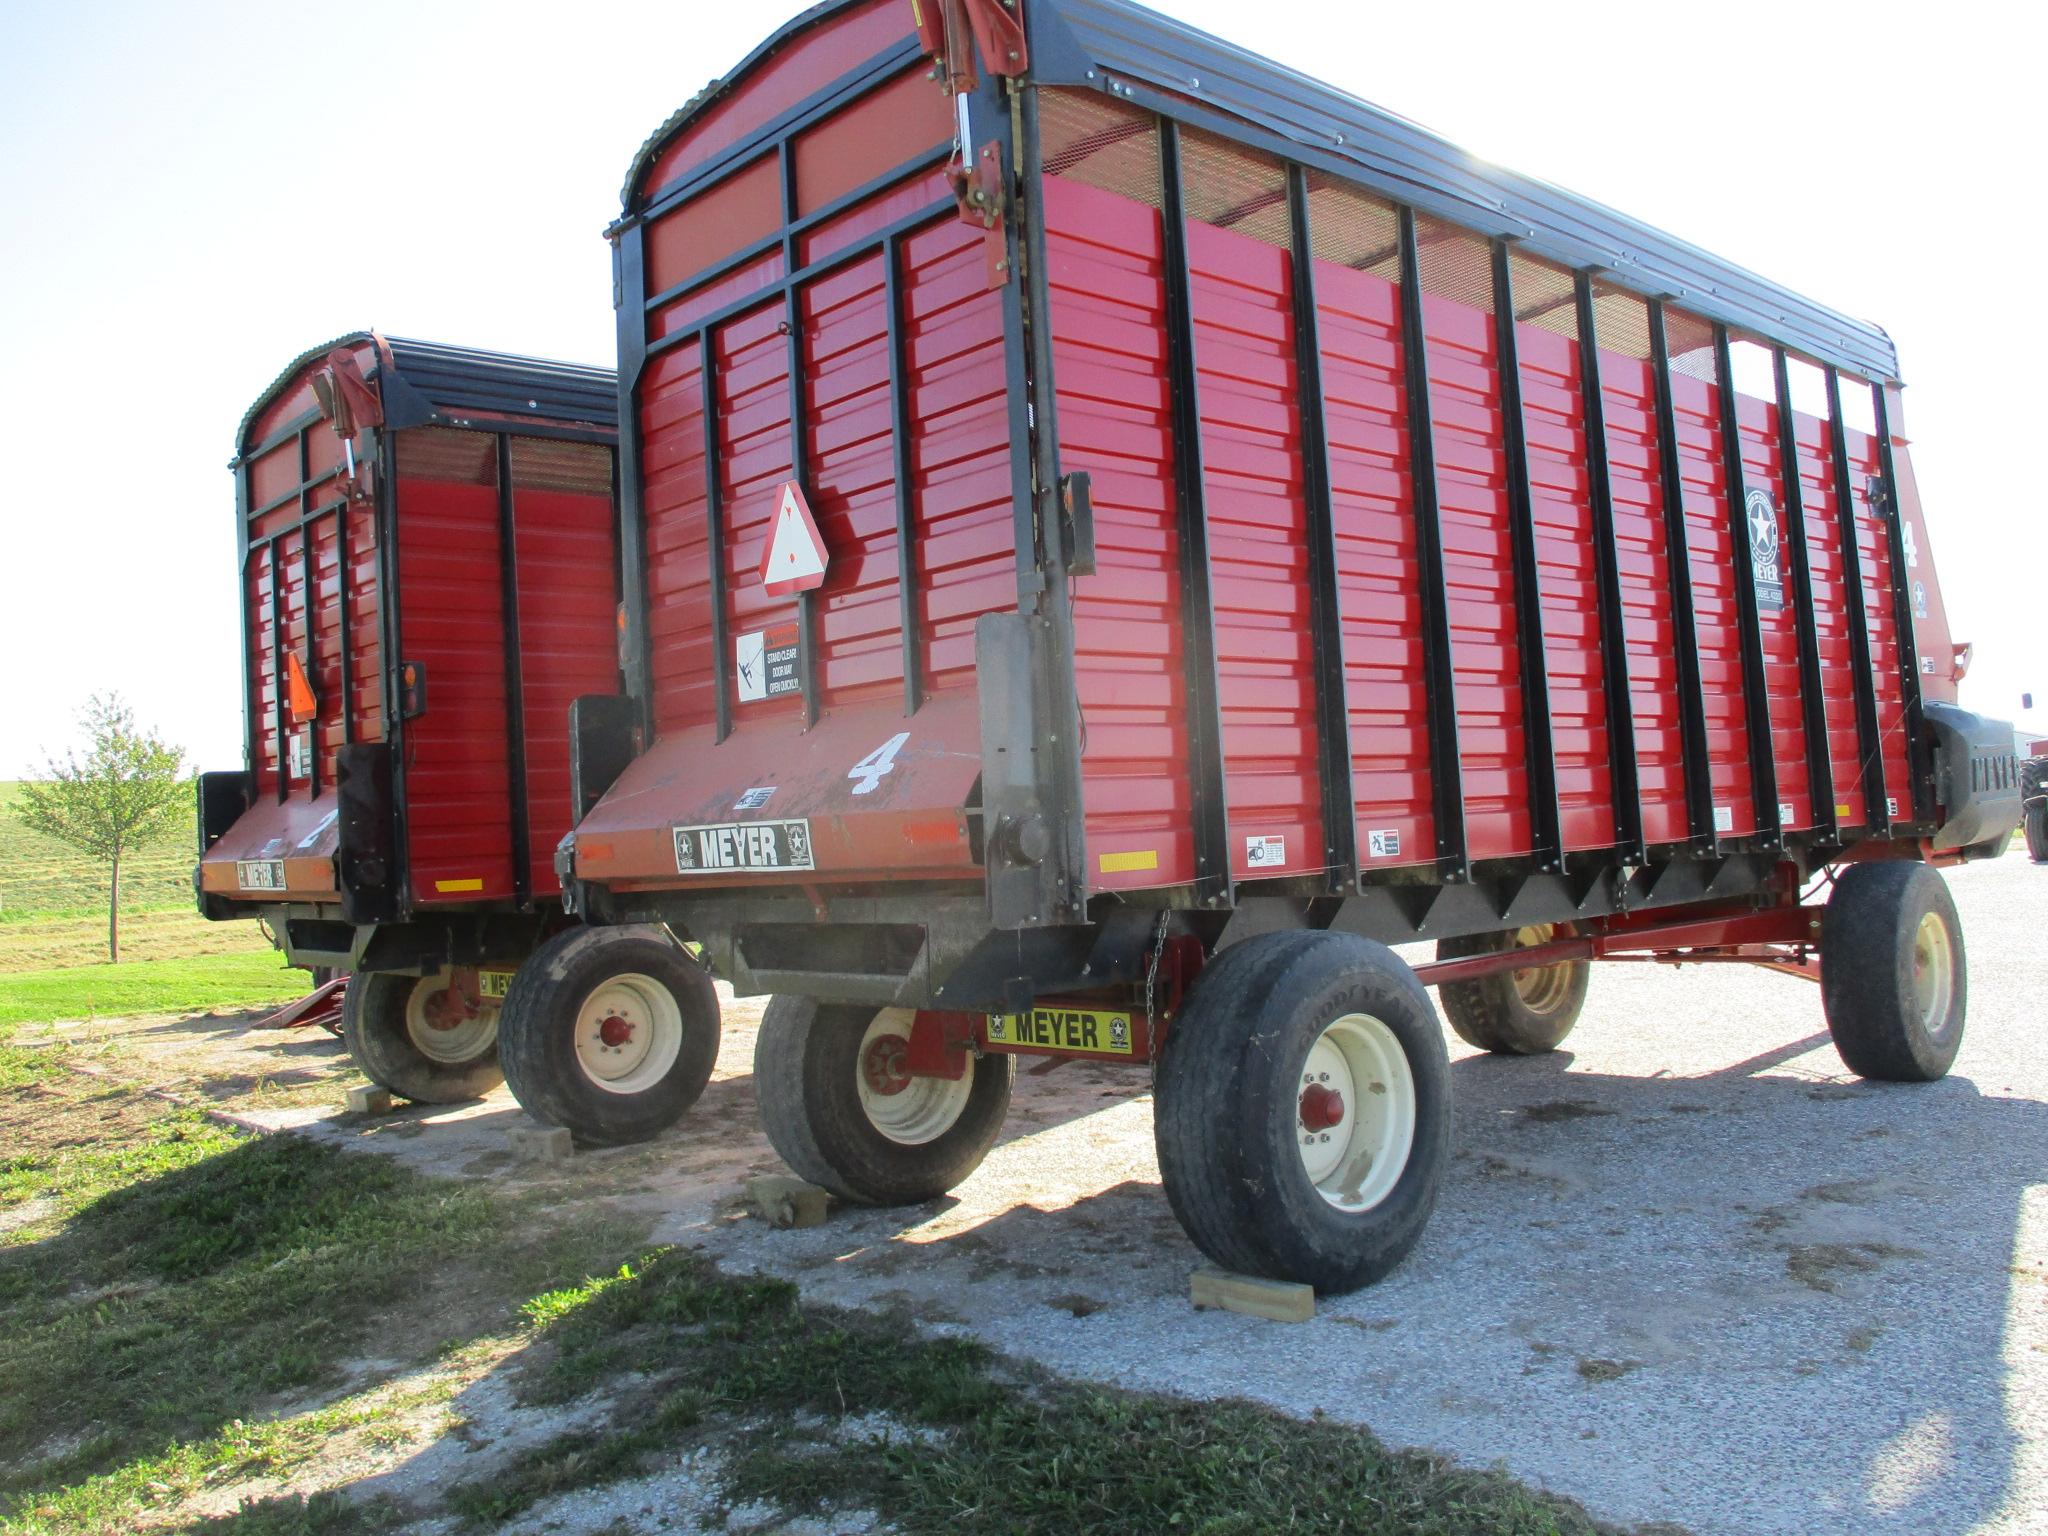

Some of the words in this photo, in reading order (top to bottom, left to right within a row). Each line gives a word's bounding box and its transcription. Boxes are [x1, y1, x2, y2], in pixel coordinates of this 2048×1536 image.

[1902, 521, 1917, 567] 4
[767, 652, 781, 664] STAND
[769, 681, 781, 693] OPEN
[848, 732, 910, 794] 4
[700, 827, 778, 868] MEYER
[246, 862, 273, 887] MEYER
[1016, 1011, 1098, 1048] MEYER
